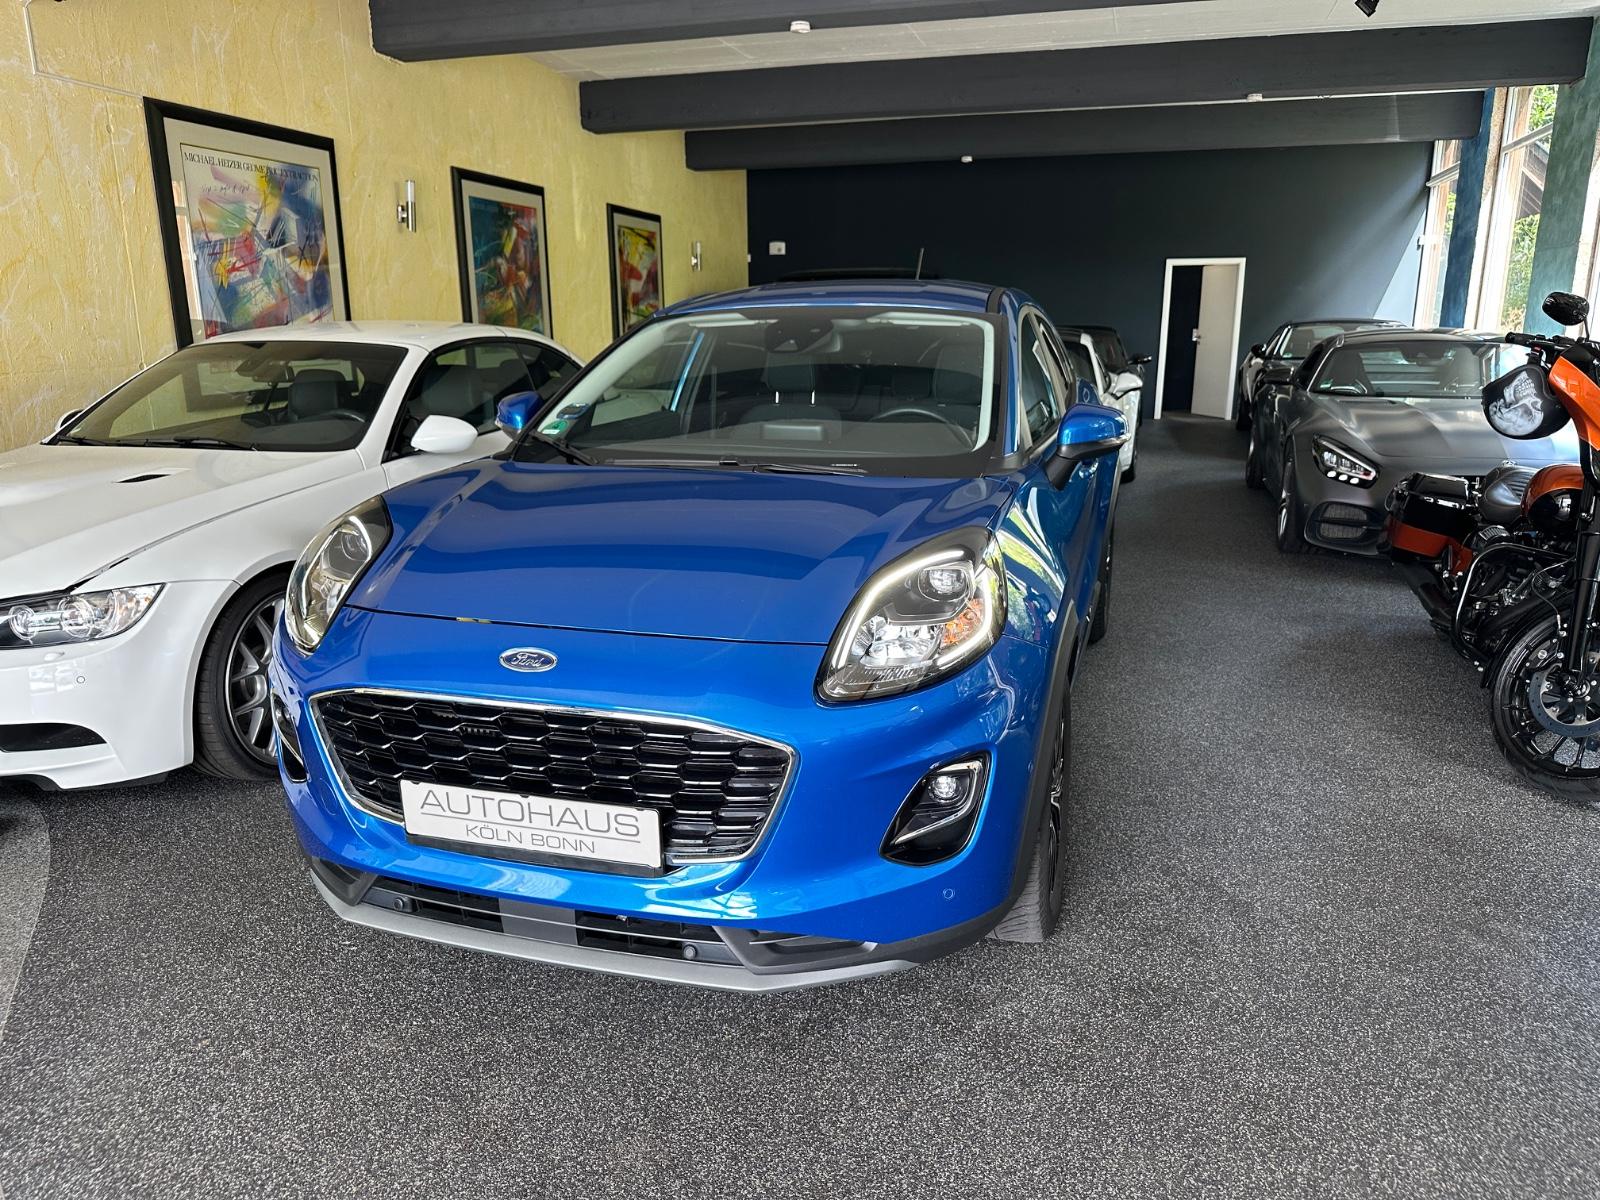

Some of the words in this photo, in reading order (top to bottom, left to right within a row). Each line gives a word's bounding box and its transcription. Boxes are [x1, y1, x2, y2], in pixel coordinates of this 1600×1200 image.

[184, 152, 216, 166] MICHAEL
[217, 158, 242, 171] HEIZER
[511, 652, 545, 667] Ford
[420, 789, 640, 837] AUTOHAUS
[466, 823, 523, 844] KÖLN
[531, 834, 595, 854] BONN
